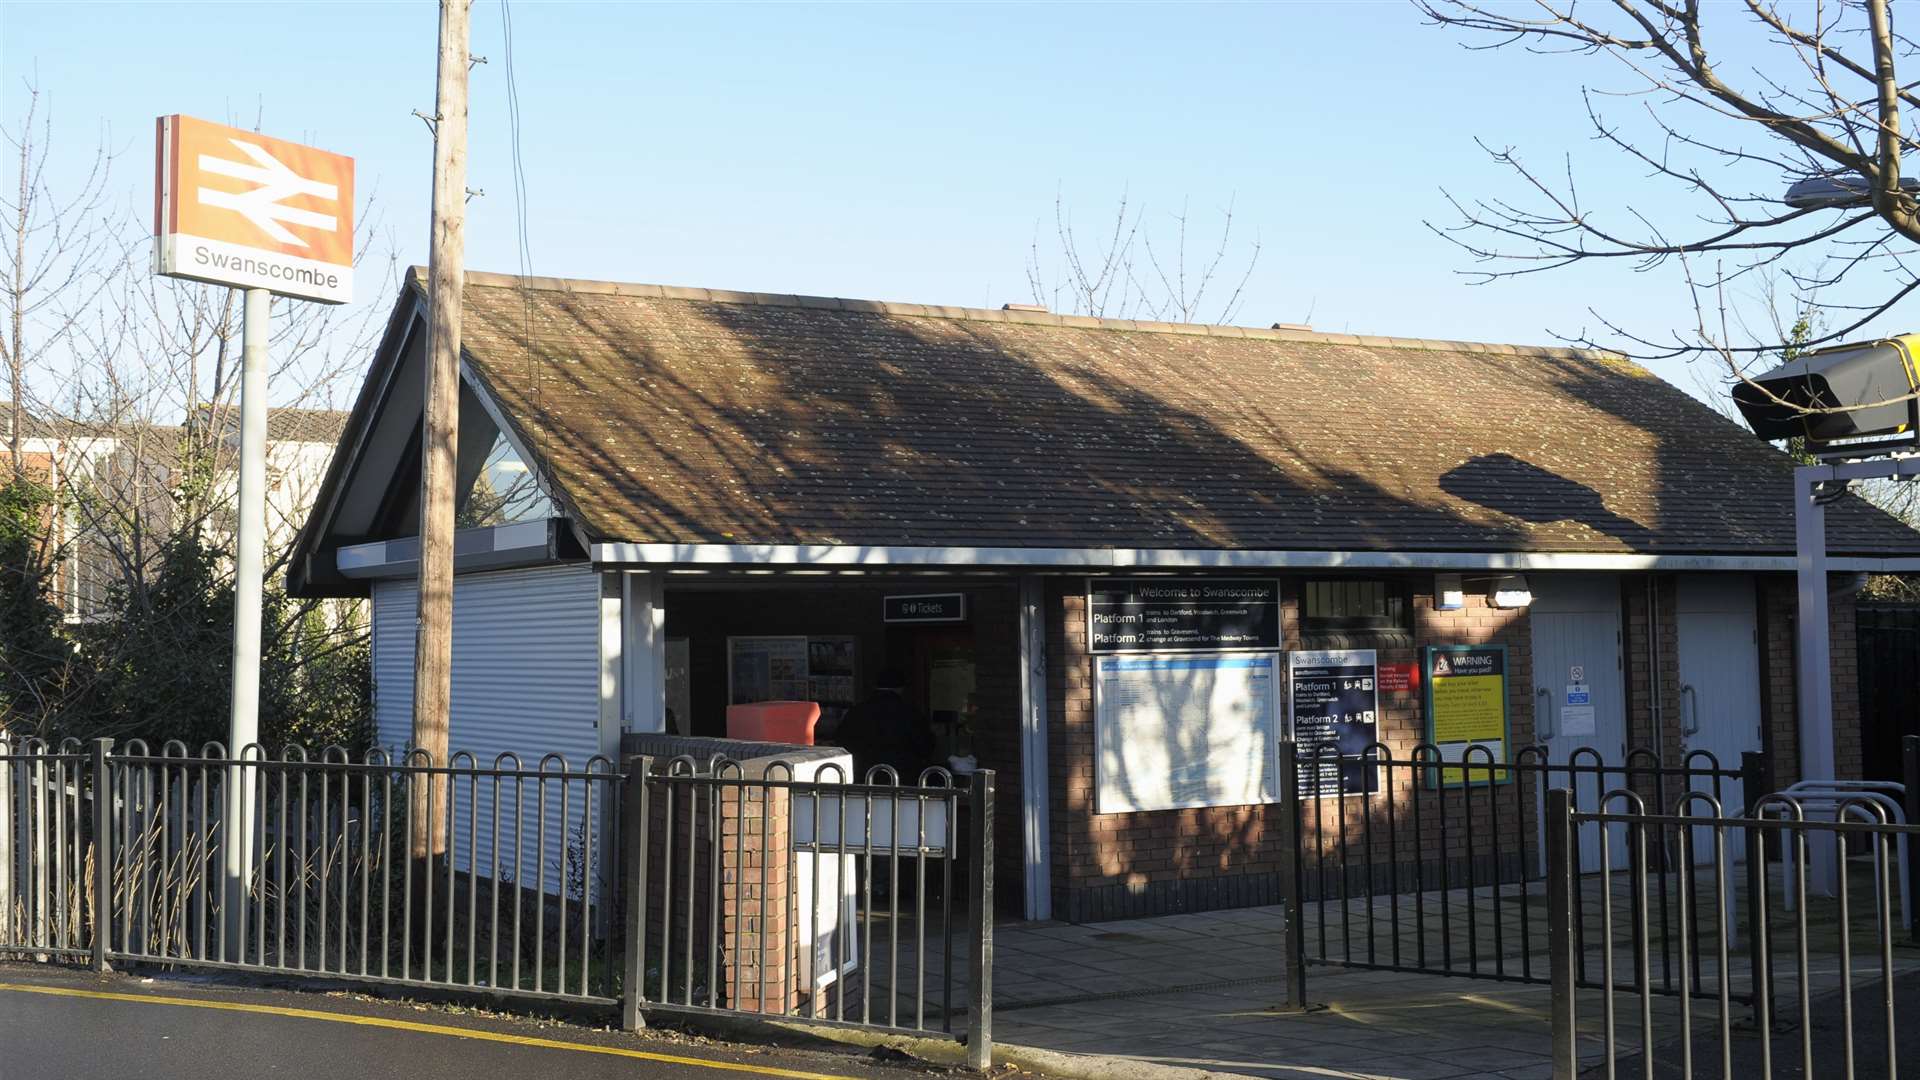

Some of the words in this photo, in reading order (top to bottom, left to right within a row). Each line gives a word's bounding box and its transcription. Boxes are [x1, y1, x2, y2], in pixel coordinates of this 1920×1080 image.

[194, 246, 338, 290] Swanscombe
[1139, 587, 1187, 598] Welcome
[1190, 588, 1200, 598] to
[1203, 587, 1270, 598] Swanscombe
[917, 602, 943, 614] Tickets
[1093, 613, 1136, 624] Platform
[1138, 613, 1144, 623] 1
[1093, 633, 1136, 643] Platform
[1138, 632, 1145, 643] 2
[1295, 655, 1349, 666] Swanscombe
[1453, 655, 1492, 666] WARNING
[1295, 682, 1330, 691] Platform
[1332, 681, 1337, 690] 1
[1296, 715, 1331, 724] Platform
[1332, 714, 1339, 723] 2
